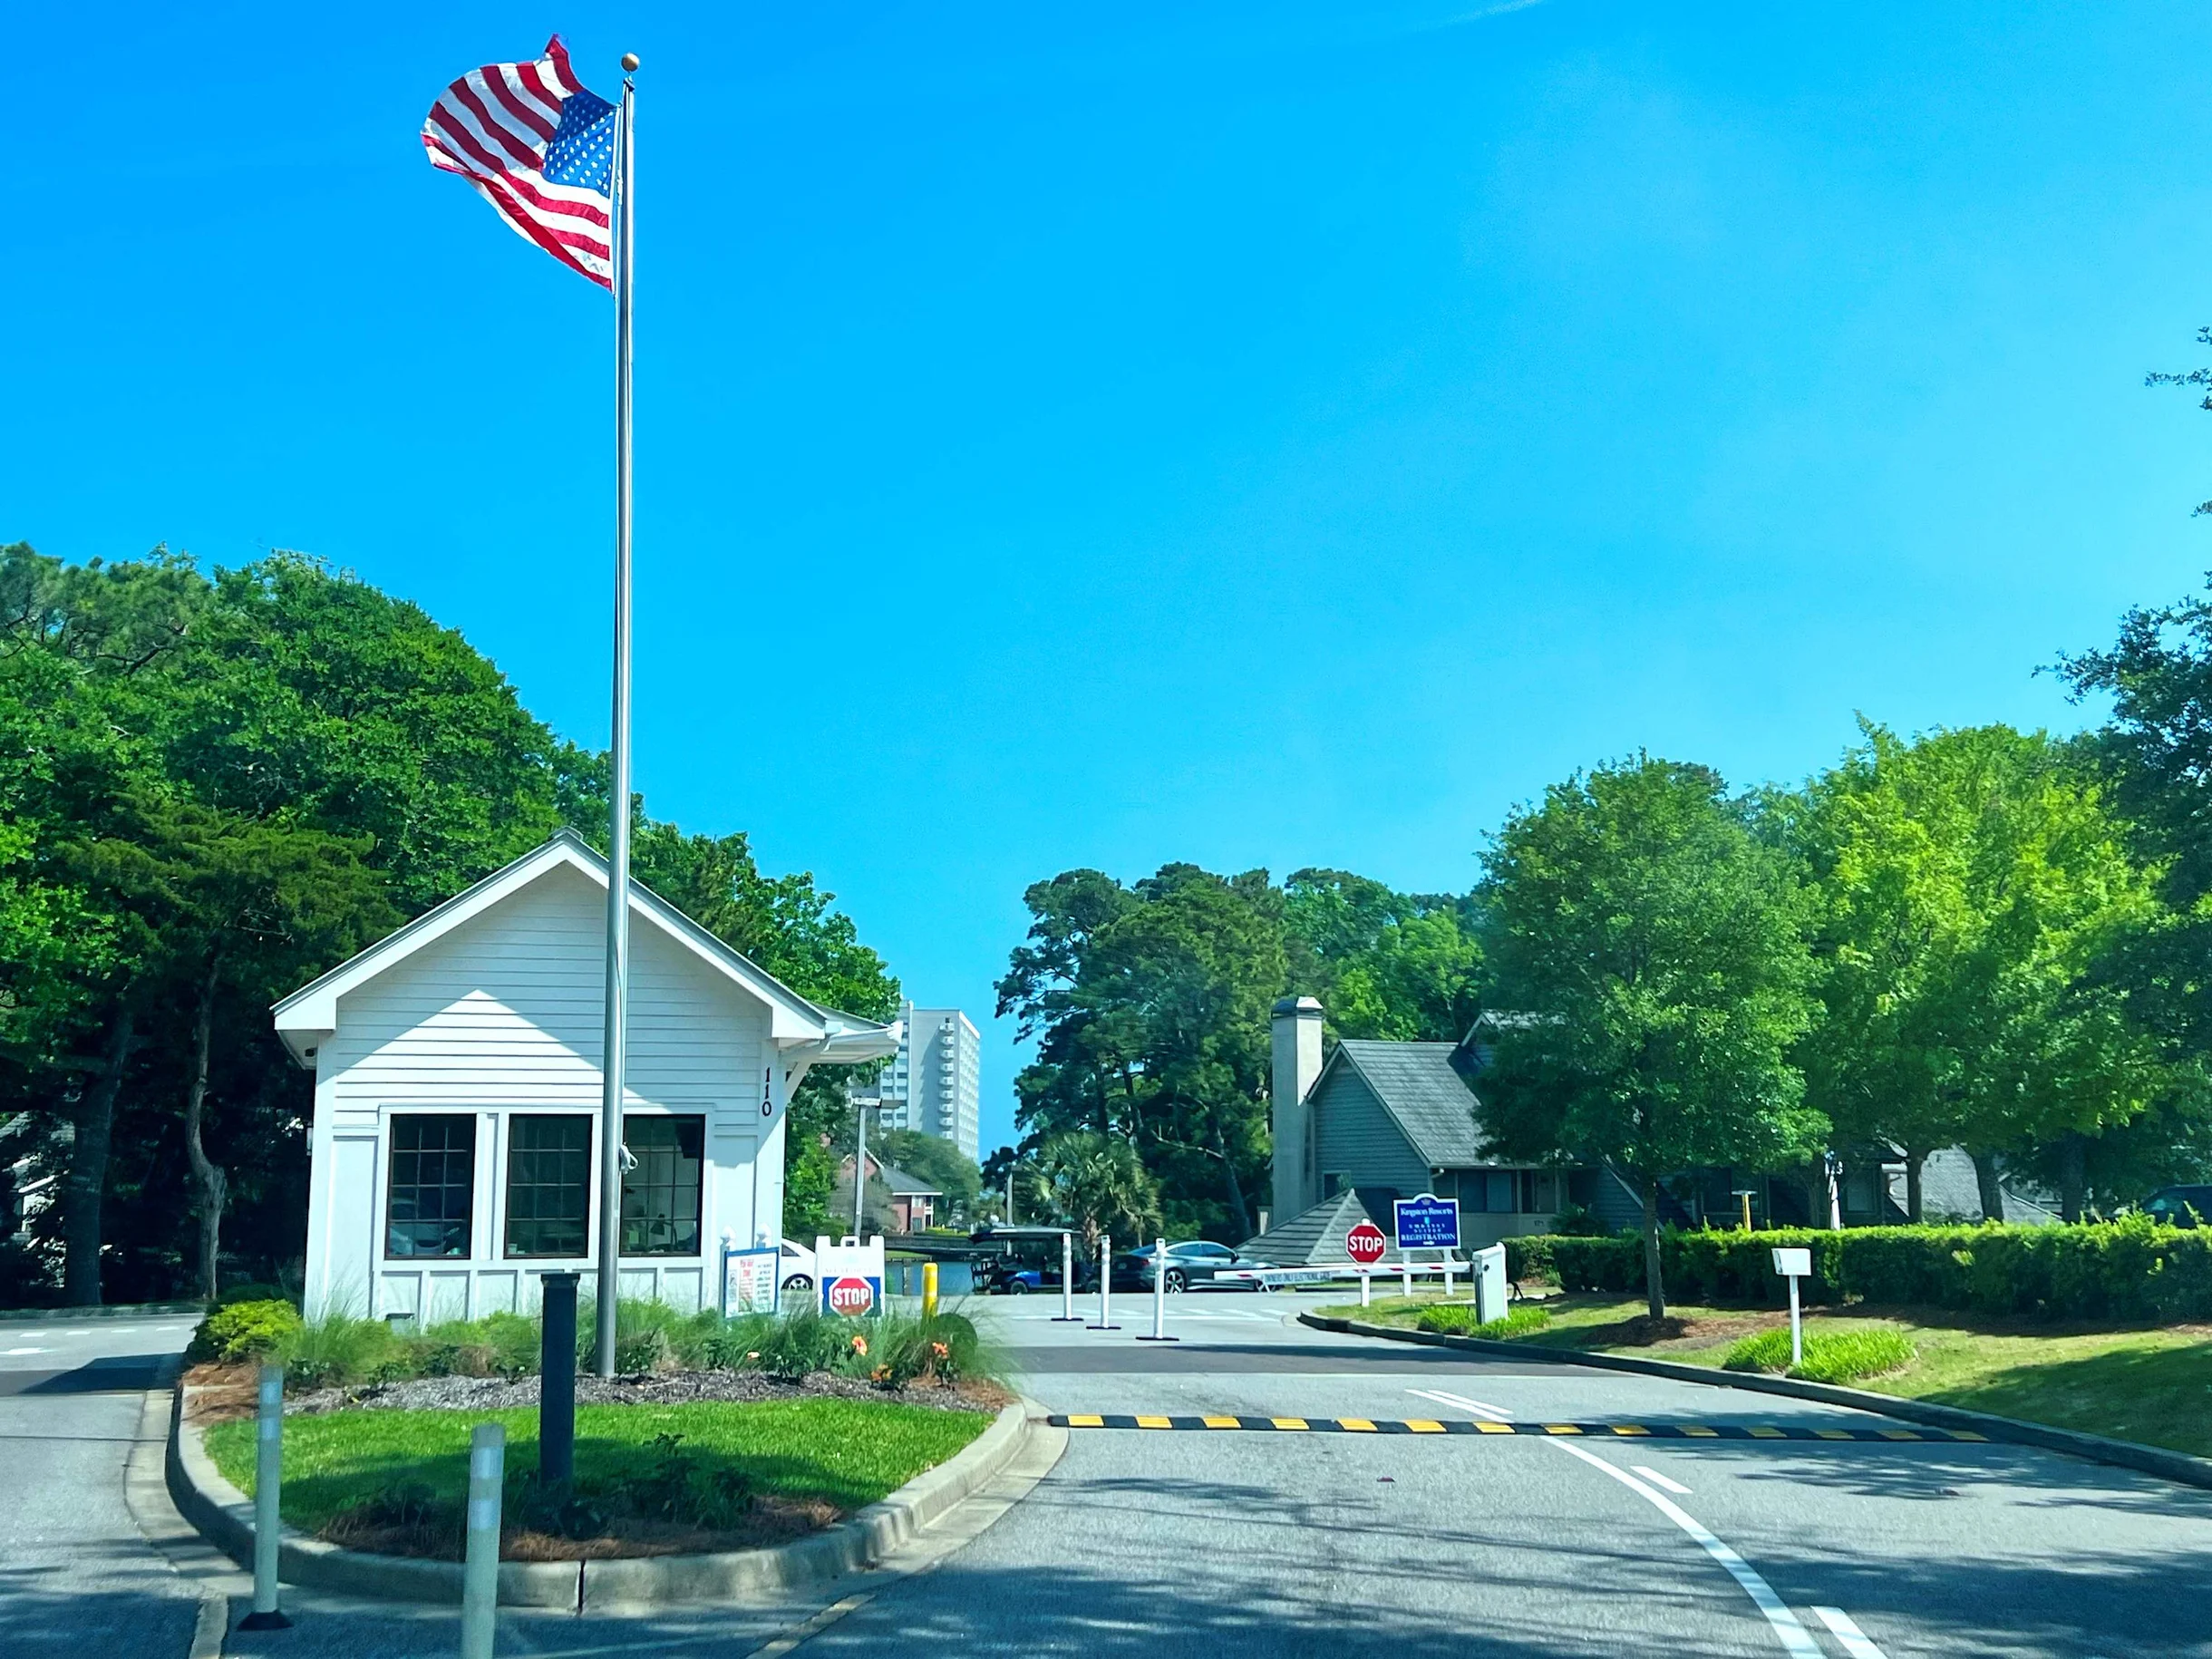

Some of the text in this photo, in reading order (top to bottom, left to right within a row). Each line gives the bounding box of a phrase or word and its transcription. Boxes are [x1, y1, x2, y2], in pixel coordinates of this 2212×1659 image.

[762, 1067, 771, 1116] 110
[1349, 1235, 1383, 1252] STOP
[1401, 1233, 1456, 1241] REGISTRATION
[833, 1287, 869, 1306] STOP
